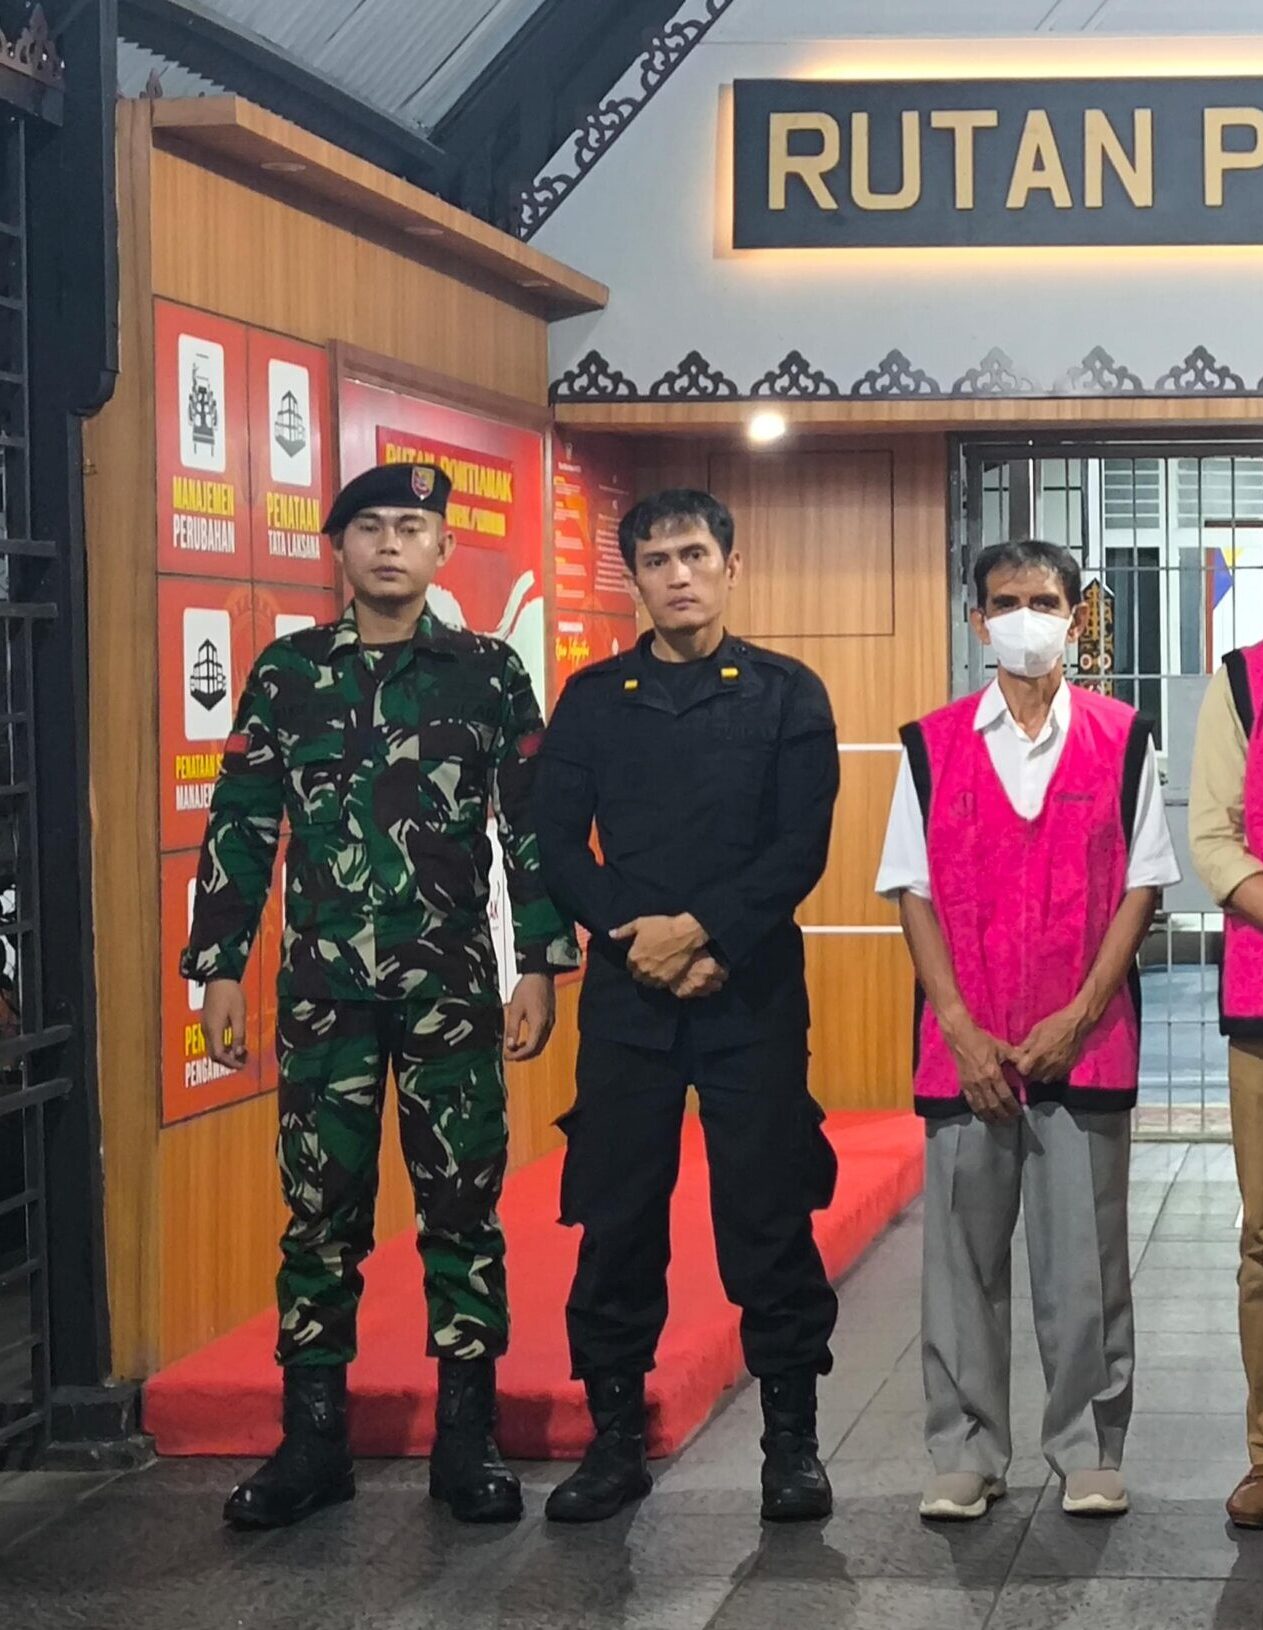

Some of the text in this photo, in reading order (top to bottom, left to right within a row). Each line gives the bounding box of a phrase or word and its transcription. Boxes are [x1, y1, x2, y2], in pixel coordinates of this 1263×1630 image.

[768, 109, 1153, 210] RUTAN
[172, 476, 234, 517] MANAJEMEN
[266, 491, 320, 533] PENATAAN
[173, 514, 235, 553] PERUBAHAN
[268, 529, 320, 560] TATA LAKSANA
